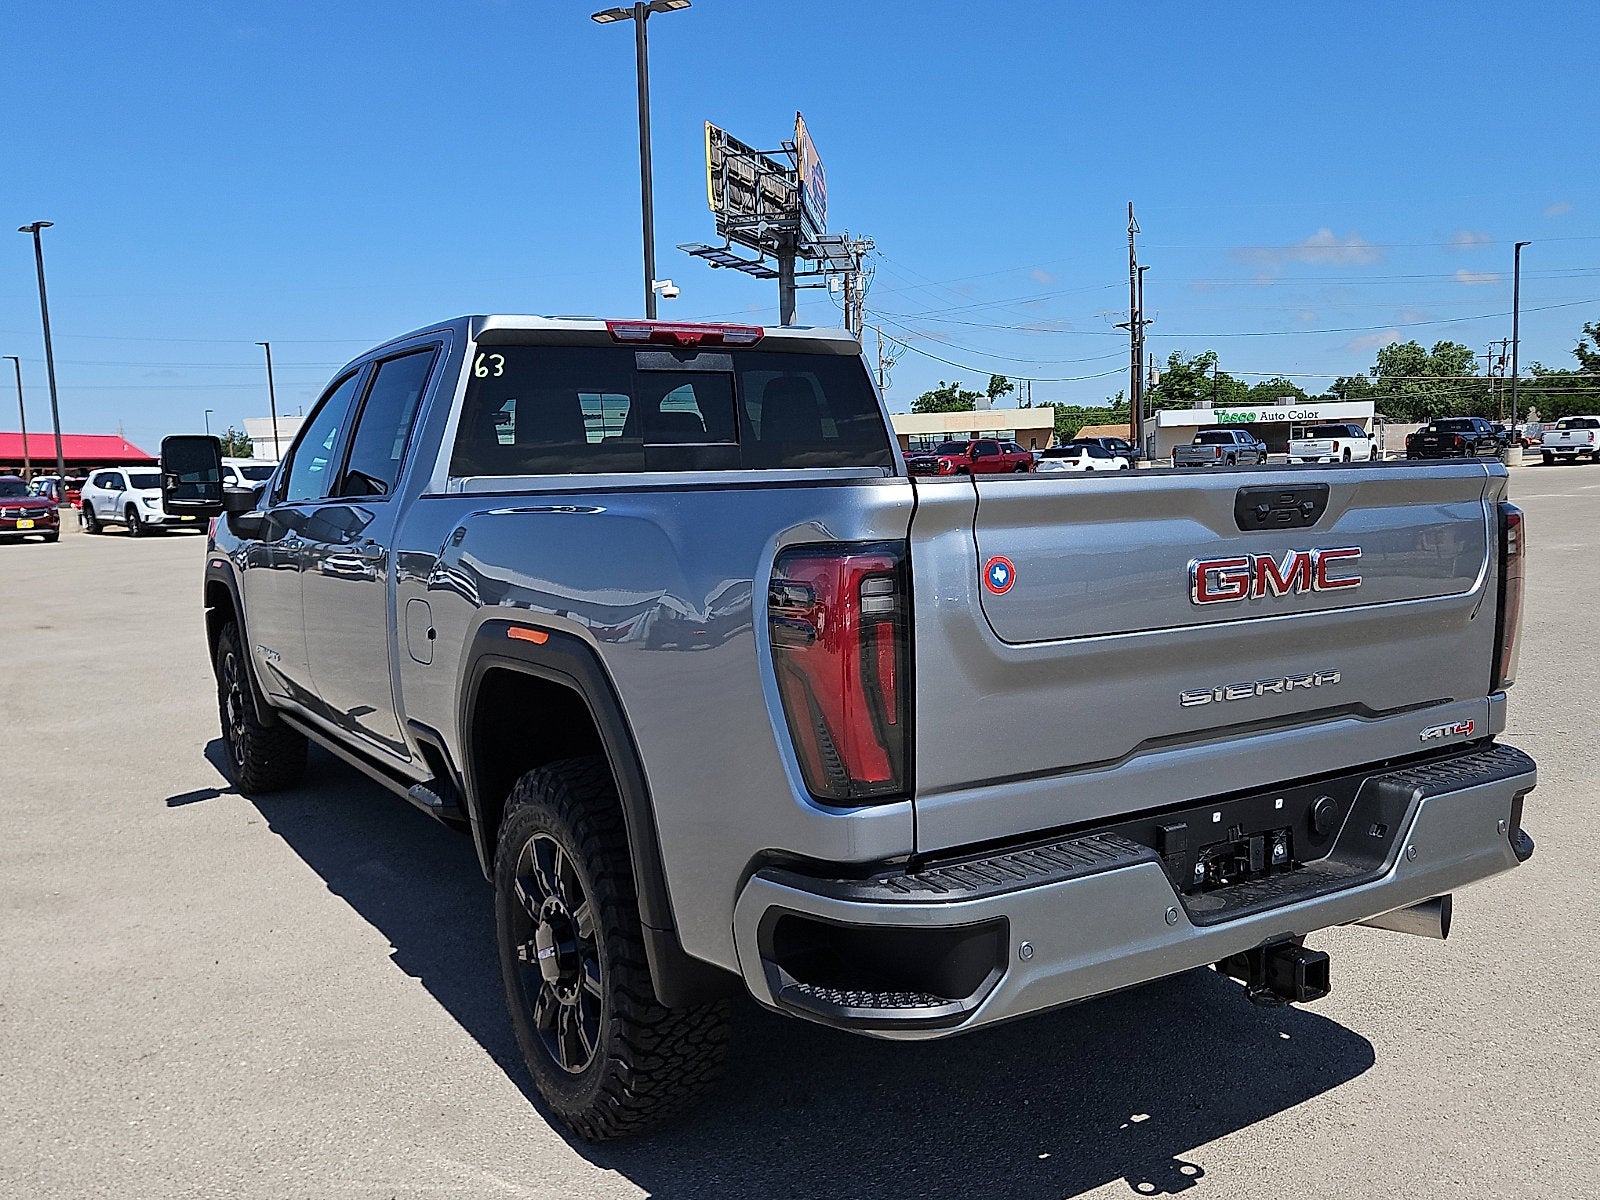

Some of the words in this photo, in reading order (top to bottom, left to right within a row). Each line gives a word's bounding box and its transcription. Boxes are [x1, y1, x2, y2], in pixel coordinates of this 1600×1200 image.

[474, 352, 505, 378] 63
[1260, 411, 1285, 421] Auto
[1288, 410, 1319, 420] Color
[1188, 546, 1362, 605] GMC
[1180, 667, 1341, 707] SIERRA
[1420, 718, 1475, 741] AT4
